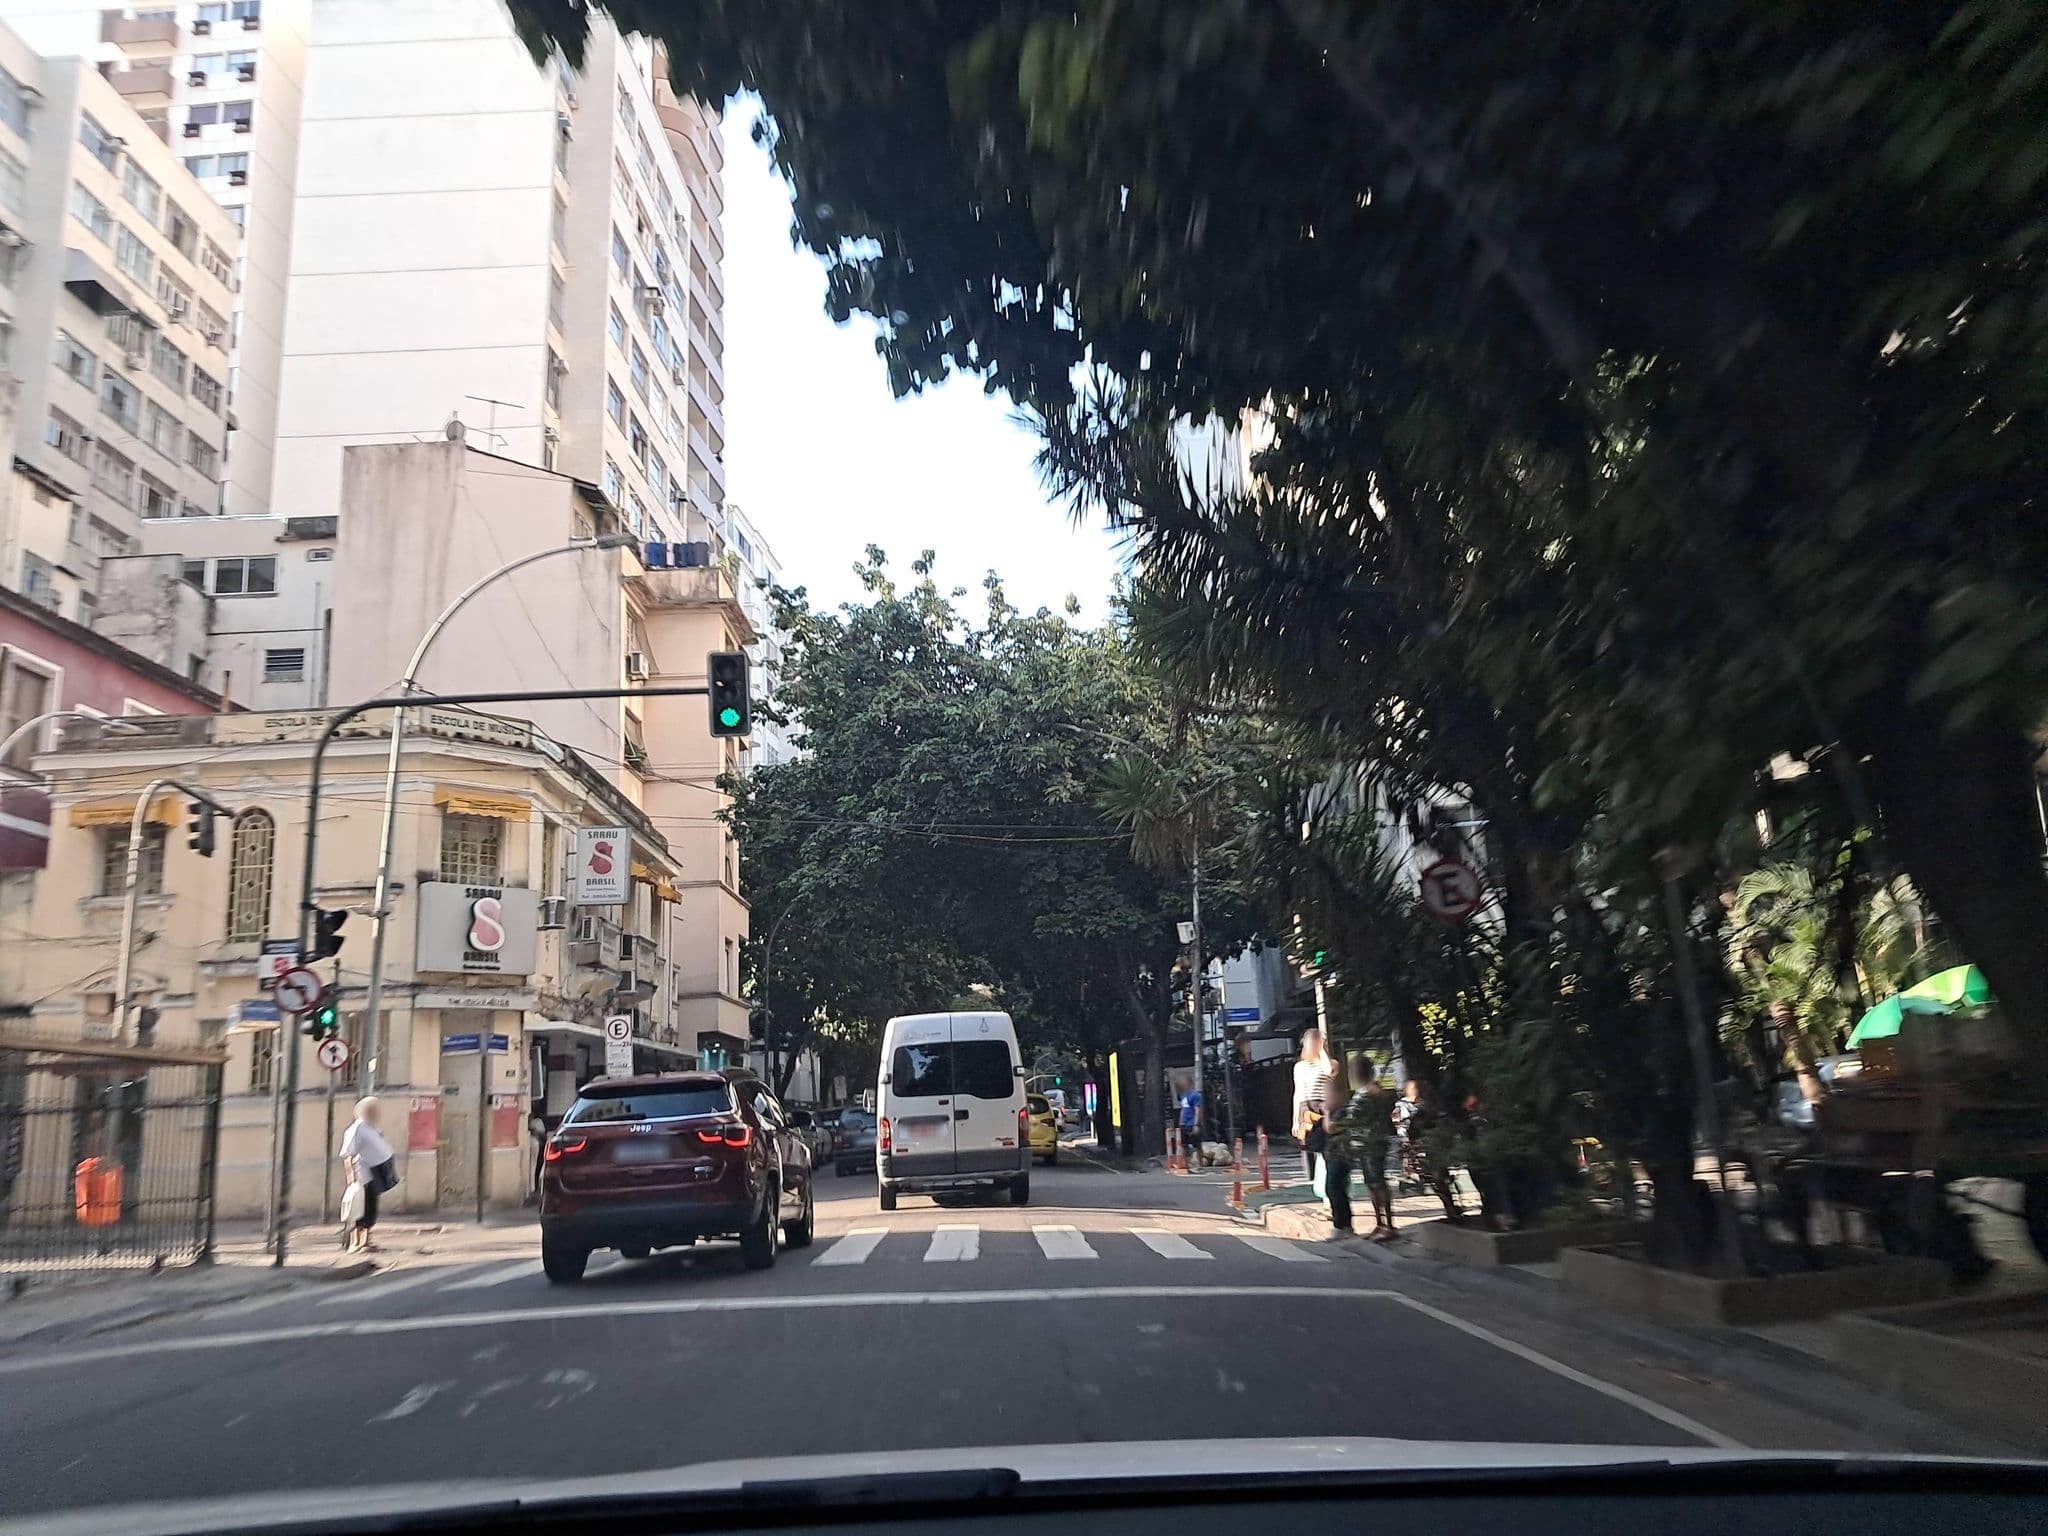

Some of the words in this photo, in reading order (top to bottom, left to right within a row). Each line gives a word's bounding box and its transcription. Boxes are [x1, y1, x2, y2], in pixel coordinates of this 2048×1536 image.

[264, 716, 306, 728] ESCOLA
[310, 715, 325, 726] DE
[430, 714, 470, 729] ESCOLA
[473, 720, 486, 731] DE
[587, 830, 618, 839] SARAU
[586, 878, 617, 886] BRASIL
[465, 887, 502, 901] SARAU
[614, 1023, 623, 1036] E
[630, 1123, 652, 1134] Jeep
